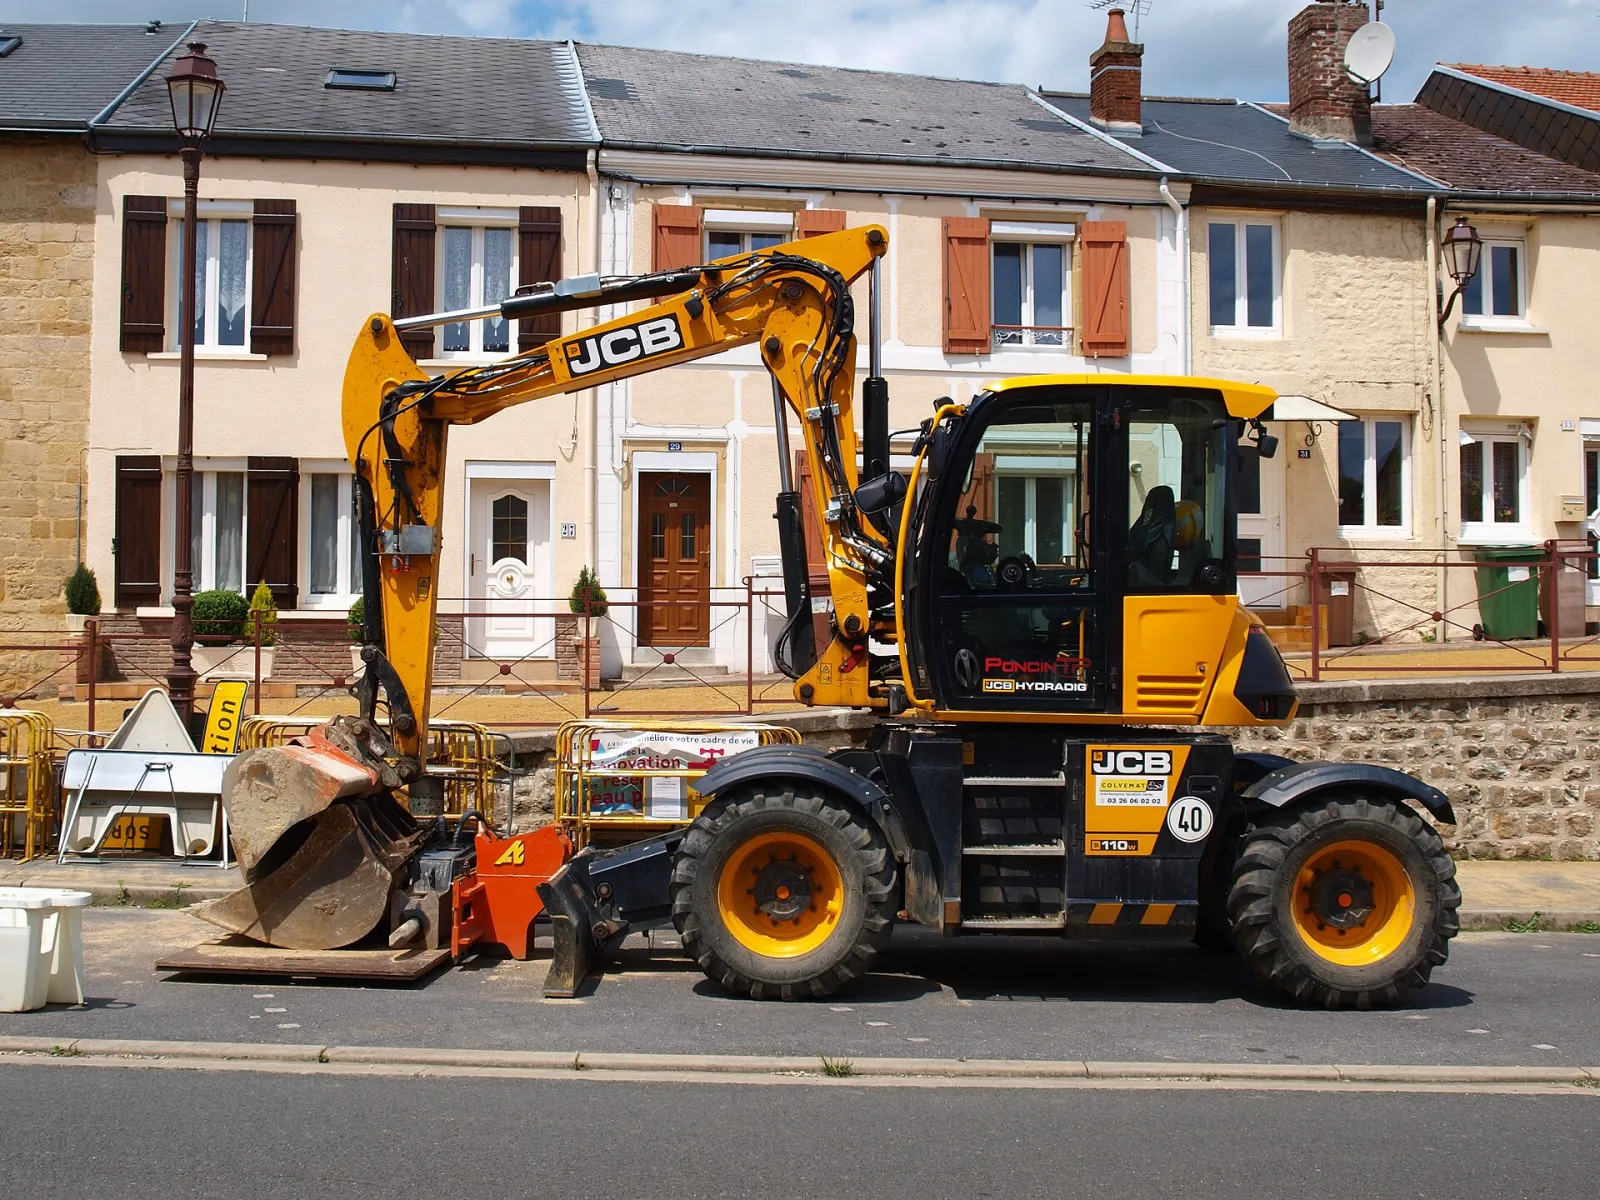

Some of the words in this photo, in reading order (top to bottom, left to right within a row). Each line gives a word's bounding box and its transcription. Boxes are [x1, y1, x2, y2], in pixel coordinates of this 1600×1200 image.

[570, 318, 681, 374] JCB
[669, 442, 681, 451] 29
[562, 524, 574, 536] 27
[985, 681, 1012, 690] JCB
[1015, 682, 1087, 692] HYDRADIG
[639, 733, 674, 742] méliore
[676, 735, 699, 743] votre
[701, 735, 727, 744] cadre
[728, 736, 739, 744] de
[741, 736, 754, 745] vie
[638, 747, 646, 755] la
[1093, 751, 1171, 774] JCB
[1178, 806, 1203, 833] 40
